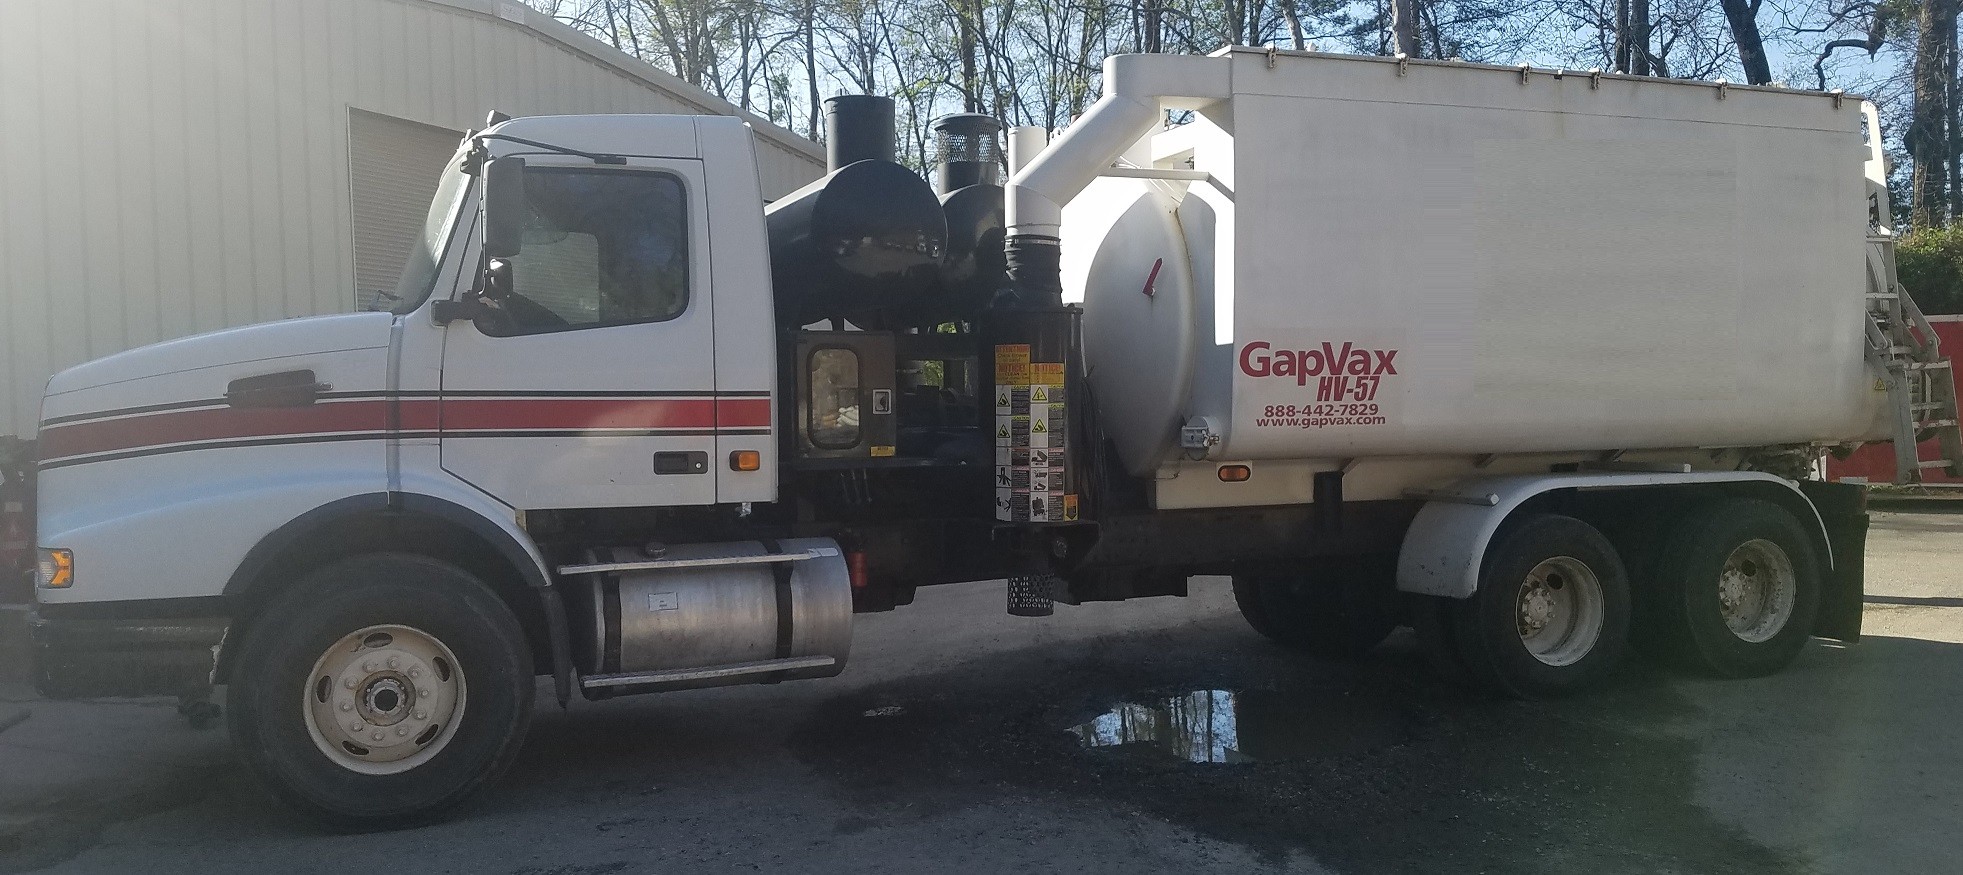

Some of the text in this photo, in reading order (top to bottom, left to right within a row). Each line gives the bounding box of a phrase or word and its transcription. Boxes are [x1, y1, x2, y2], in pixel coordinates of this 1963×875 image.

[1239, 341, 1398, 386] GapVax
[1316, 376, 1380, 401] HV-57
[1264, 404, 1379, 417] 888-442-7829
[1256, 415, 1386, 429] www.gapvax.com
